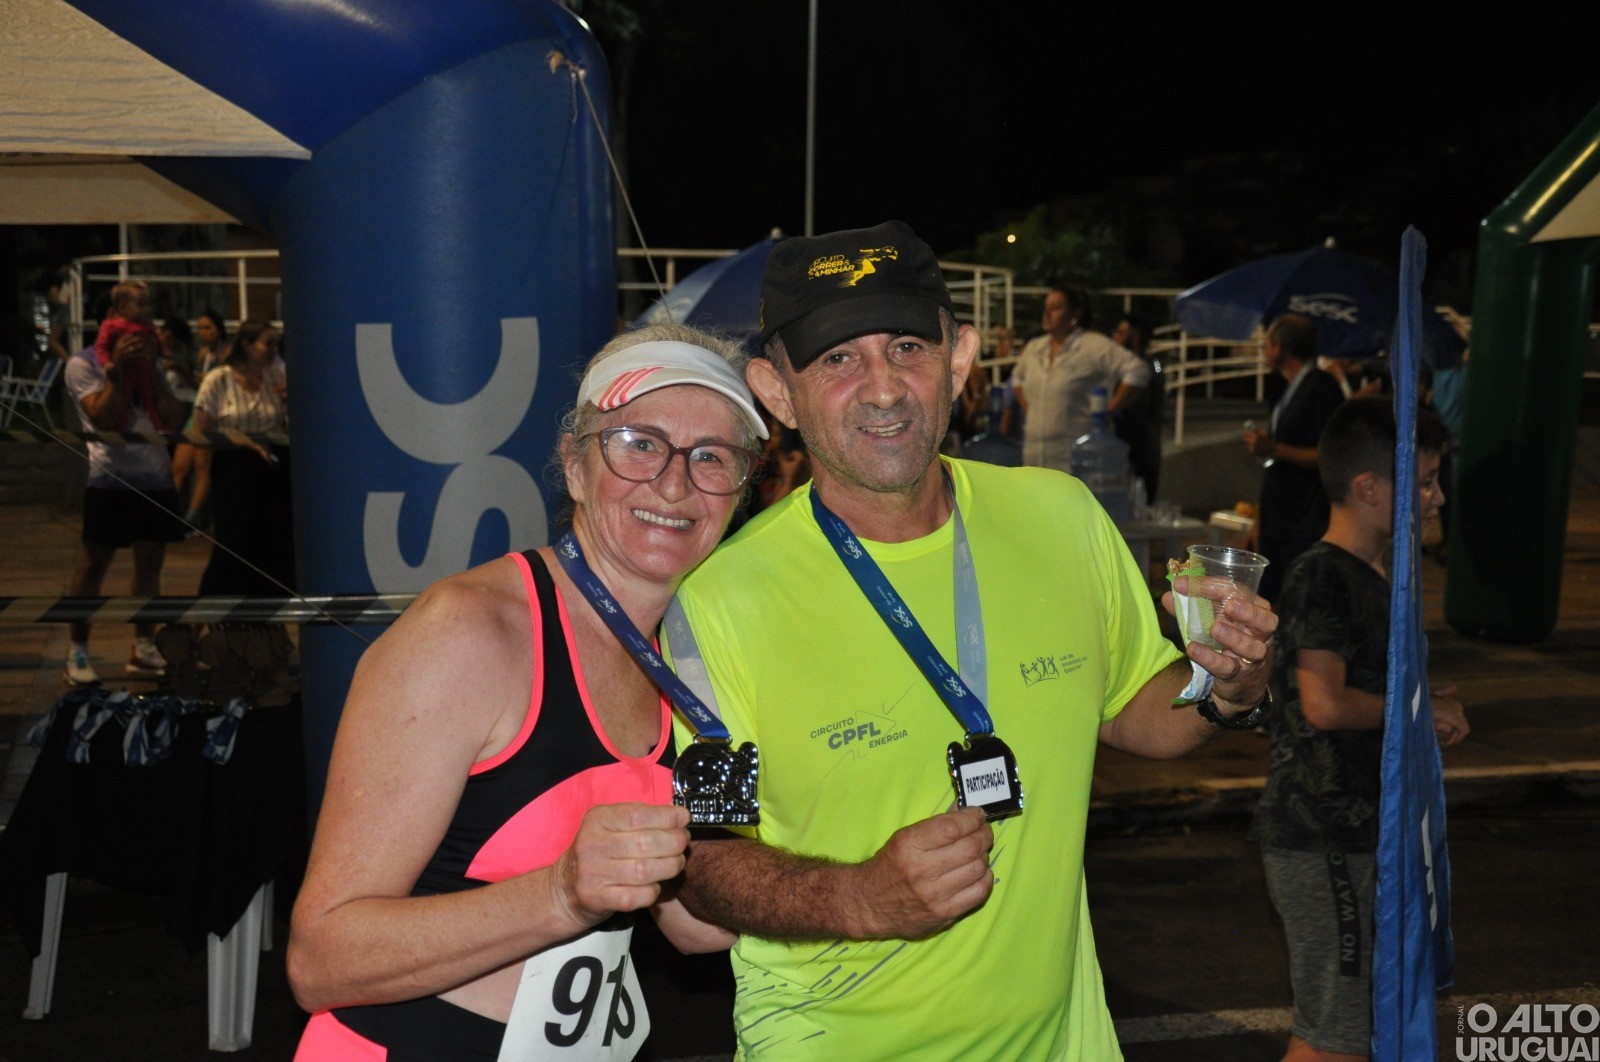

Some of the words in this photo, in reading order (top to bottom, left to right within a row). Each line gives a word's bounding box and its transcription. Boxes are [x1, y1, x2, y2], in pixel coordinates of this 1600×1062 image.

[808, 264, 856, 280] AMINHAR
[810, 717, 854, 739] CIRCUITO
[827, 721, 882, 750] CPFL
[869, 729, 908, 749] ENERGIA
[965, 768, 1006, 794] PARTICIPAÇÃO
[1333, 876, 1356, 922] WAY
[1342, 933, 1357, 962] NO
